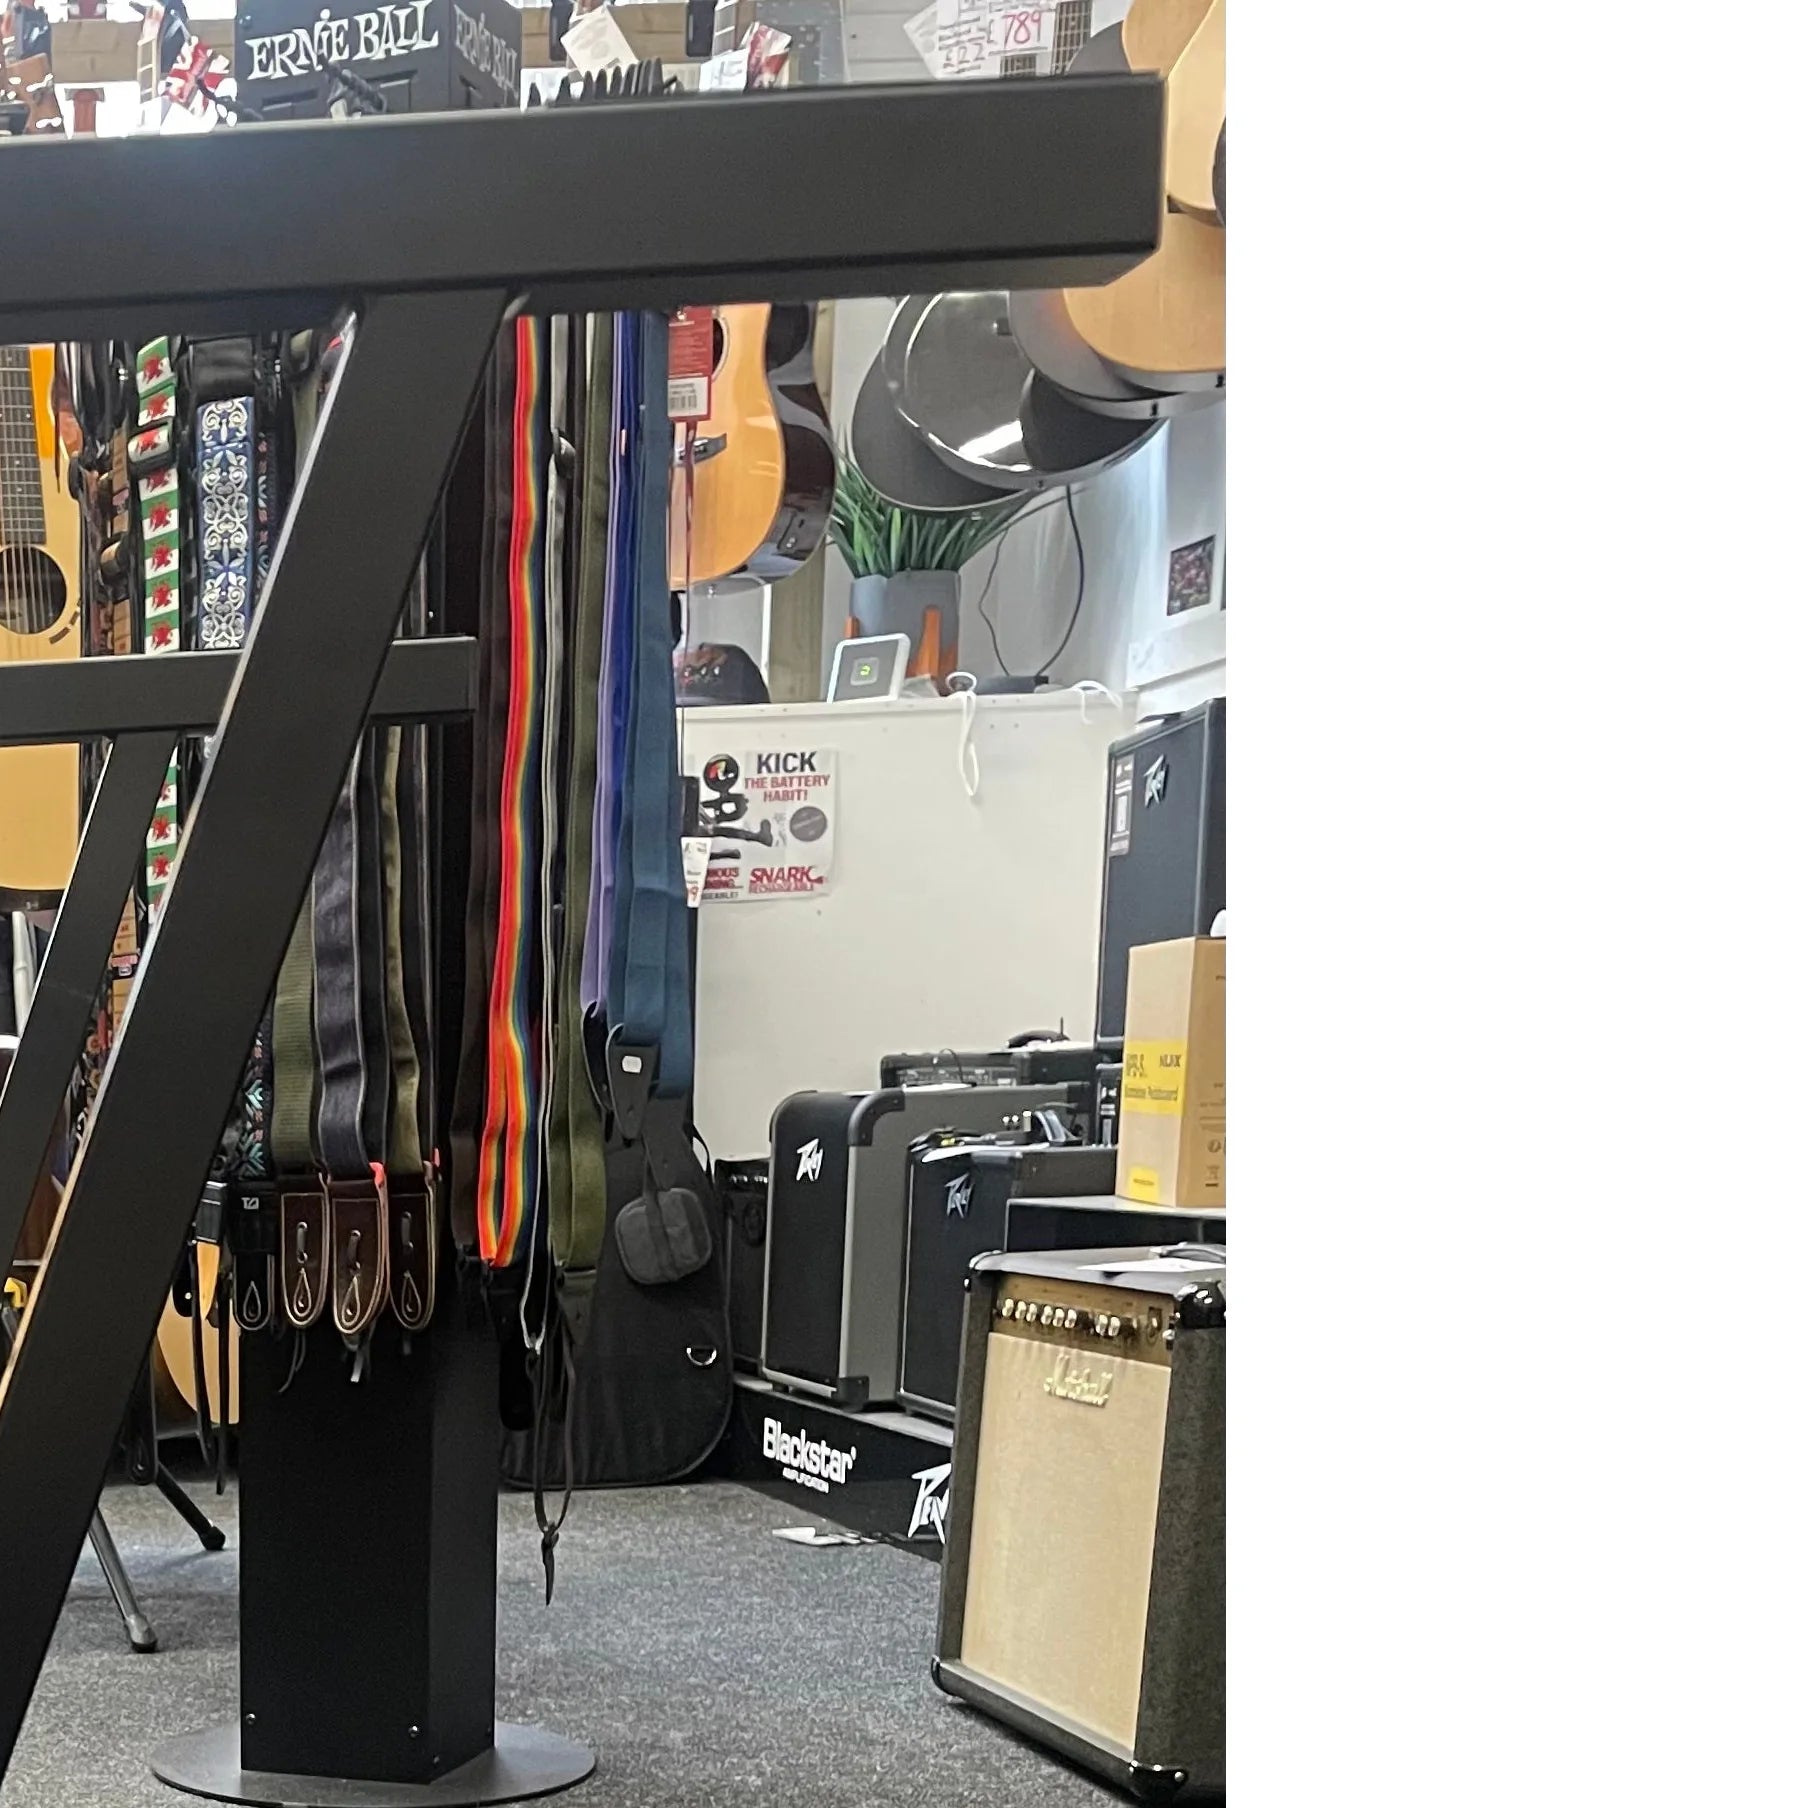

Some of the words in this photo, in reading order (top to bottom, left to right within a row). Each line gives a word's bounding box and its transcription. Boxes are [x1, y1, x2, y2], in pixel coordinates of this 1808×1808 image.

[353, 0, 439, 61] BALL
[757, 751, 817, 774] KICK
[744, 777, 767, 790] THE
[771, 774, 831, 788] BATTERY
[749, 865, 824, 885] SNARK
[763, 1416, 856, 1485] Blackstar
